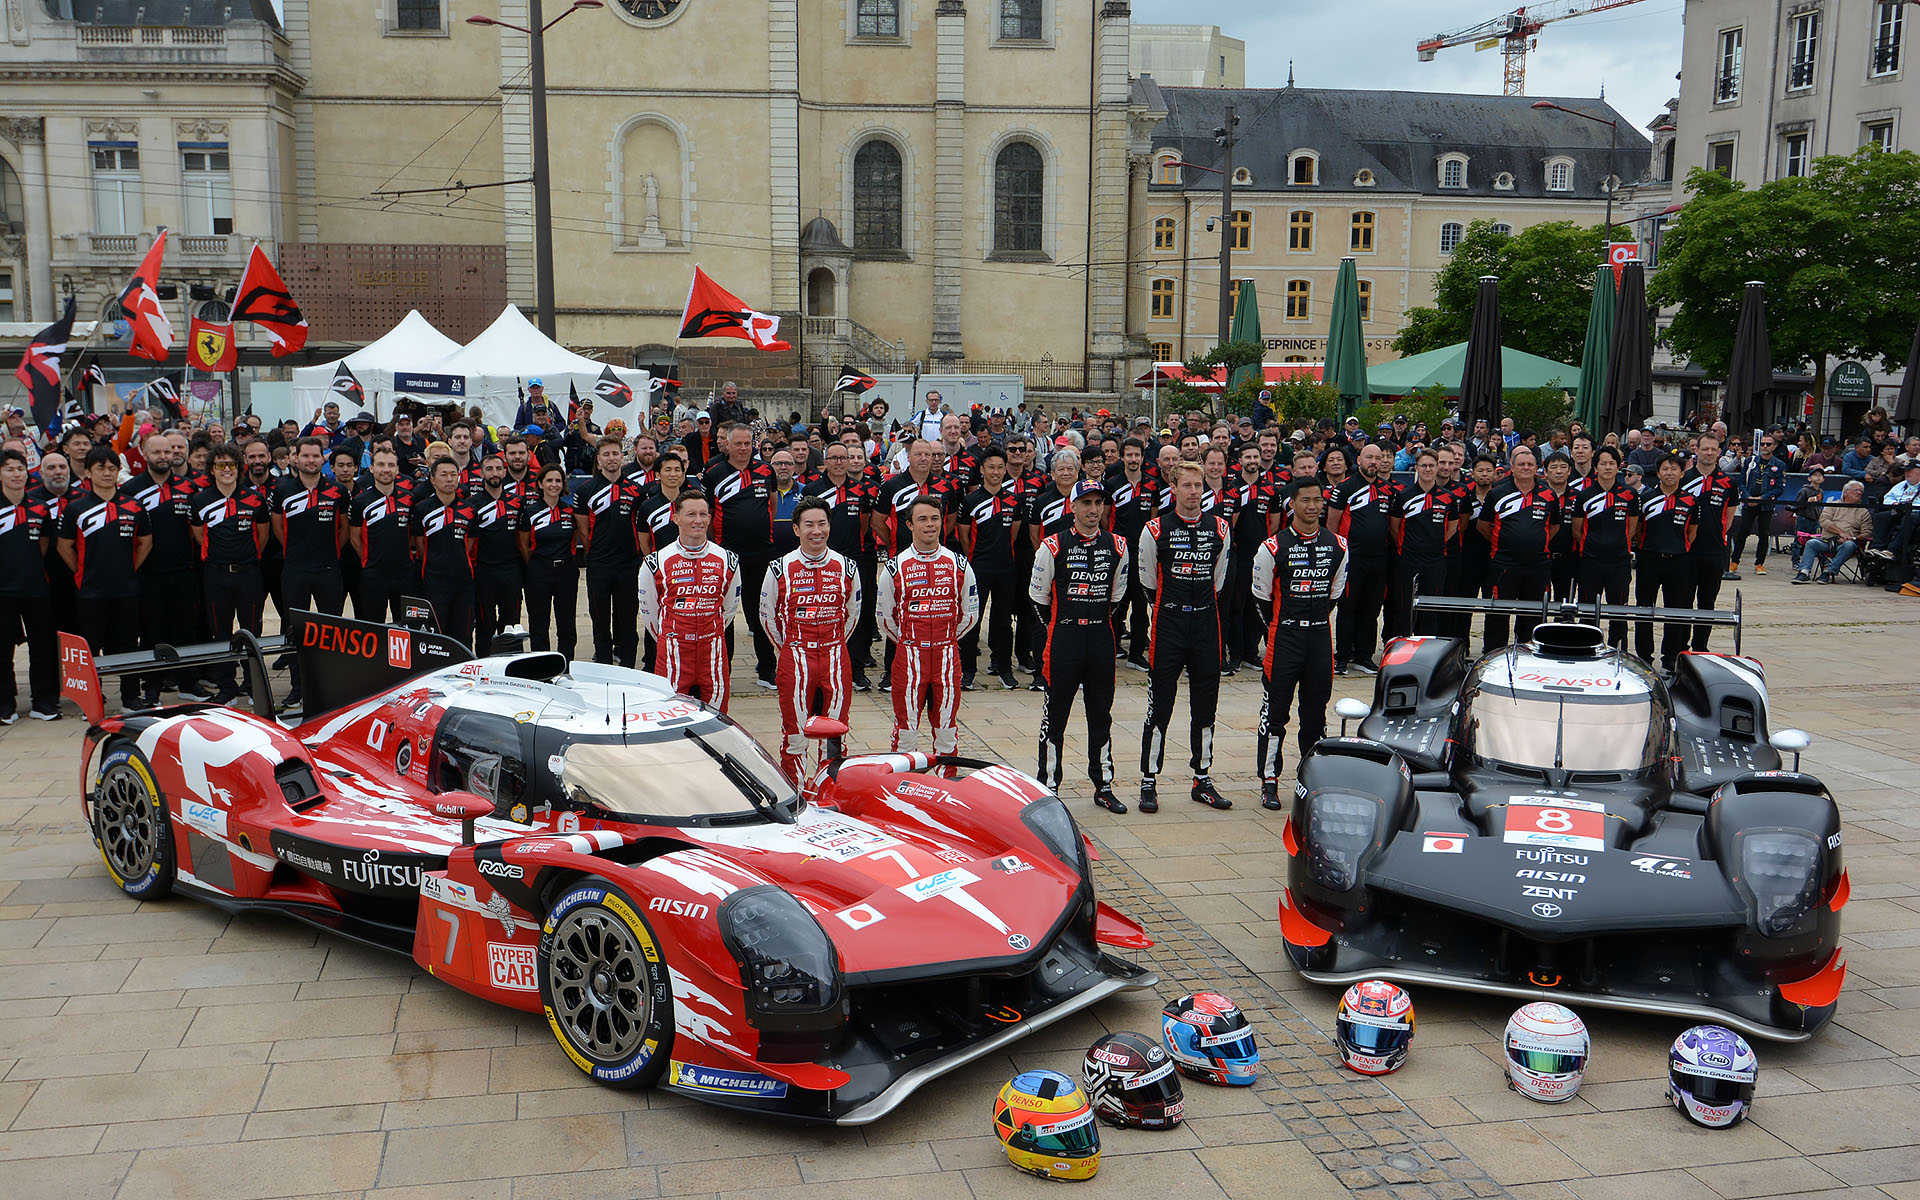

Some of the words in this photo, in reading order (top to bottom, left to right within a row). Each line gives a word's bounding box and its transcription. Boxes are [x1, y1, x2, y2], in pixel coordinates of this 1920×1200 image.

[1375, 340, 1391, 350] SP
[1847, 365, 1856, 374] La
[1838, 374, 1864, 385] Réserve
[1170, 528, 1189, 537] FUJITSU
[1068, 546, 1087, 555] FUJITSU
[1289, 544, 1307, 553] FUJITSU
[1174, 551, 1211, 560] DENSO
[672, 560, 692, 569] FUJITSU
[906, 563, 926, 572] FUJITSU
[794, 569, 813, 578] FUJITSU
[1071, 571, 1107, 581] DENSO
[1293, 569, 1329, 577] DENSO
[677, 585, 716, 595] DENSO
[912, 587, 949, 597] DENSO
[1068, 587, 1088, 595] GR
[797, 594, 836, 604] DENSO
[674, 601, 695, 609] GR
[909, 603, 929, 611] GR
[796, 610, 816, 618] GR
[303, 621, 378, 658] DENSO
[390, 636, 409, 661] HY
[62, 648, 88, 665] JFE
[460, 664, 482, 675] ZENT
[1519, 673, 1611, 687] DENSO
[622, 703, 698, 722] DENSO
[102, 752, 128, 773] MICHELIN
[896, 785, 915, 795] GR
[916, 788, 936, 796] GAZOO
[919, 784, 940, 792] TOYOTA
[913, 791, 933, 799] Racing
[936, 790, 946, 802] 7
[189, 805, 219, 822] WEC
[436, 804, 456, 814] Mobil
[1536, 809, 1573, 832] 8
[784, 821, 839, 838] FUJITSU
[807, 827, 855, 842] AISIN
[824, 833, 864, 847] ZENT
[1528, 833, 1580, 842] WEC
[515, 844, 533, 853] GR
[1515, 847, 1588, 865] FUJITSU
[342, 849, 421, 889] FUJITSU
[478, 859, 524, 879] RAYS
[867, 849, 920, 879] 7
[1515, 869, 1587, 884] AISIN
[1656, 870, 1691, 879] MANS
[424, 875, 441, 893] 24h
[915, 871, 957, 892] WEC
[1522, 885, 1578, 900] ZENT
[555, 890, 600, 916] MICHELIN
[649, 896, 709, 920] AISIN
[608, 898, 624, 911] PILOT
[622, 909, 639, 928] SPORT
[436, 908, 459, 965] 7
[491, 947, 533, 964] HYPER
[644, 945, 656, 958] M
[493, 962, 536, 986] CAR
[1182, 1011, 1212, 1023] DENSO
[1371, 1008, 1385, 1016] Bull
[1220, 1033, 1243, 1042] TOYOTA
[1518, 1043, 1542, 1051] TOYOTA
[1095, 1049, 1128, 1064] DENSO
[1352, 1054, 1382, 1065] DENSO
[1705, 1053, 1726, 1064] Arai
[597, 1058, 643, 1079] MICHELIN
[1682, 1066, 1708, 1075] TOYOTA
[1709, 1071, 1735, 1079] GAZOO
[700, 1074, 777, 1090] MICHELIN
[1141, 1073, 1164, 1083] TOYOTA
[1531, 1079, 1563, 1089] DENSO
[1010, 1094, 1043, 1108] DENSO
[1695, 1105, 1730, 1116] DENSO
[1703, 1114, 1721, 1122] ZENT
[1057, 1120, 1083, 1131] TOYOTA
